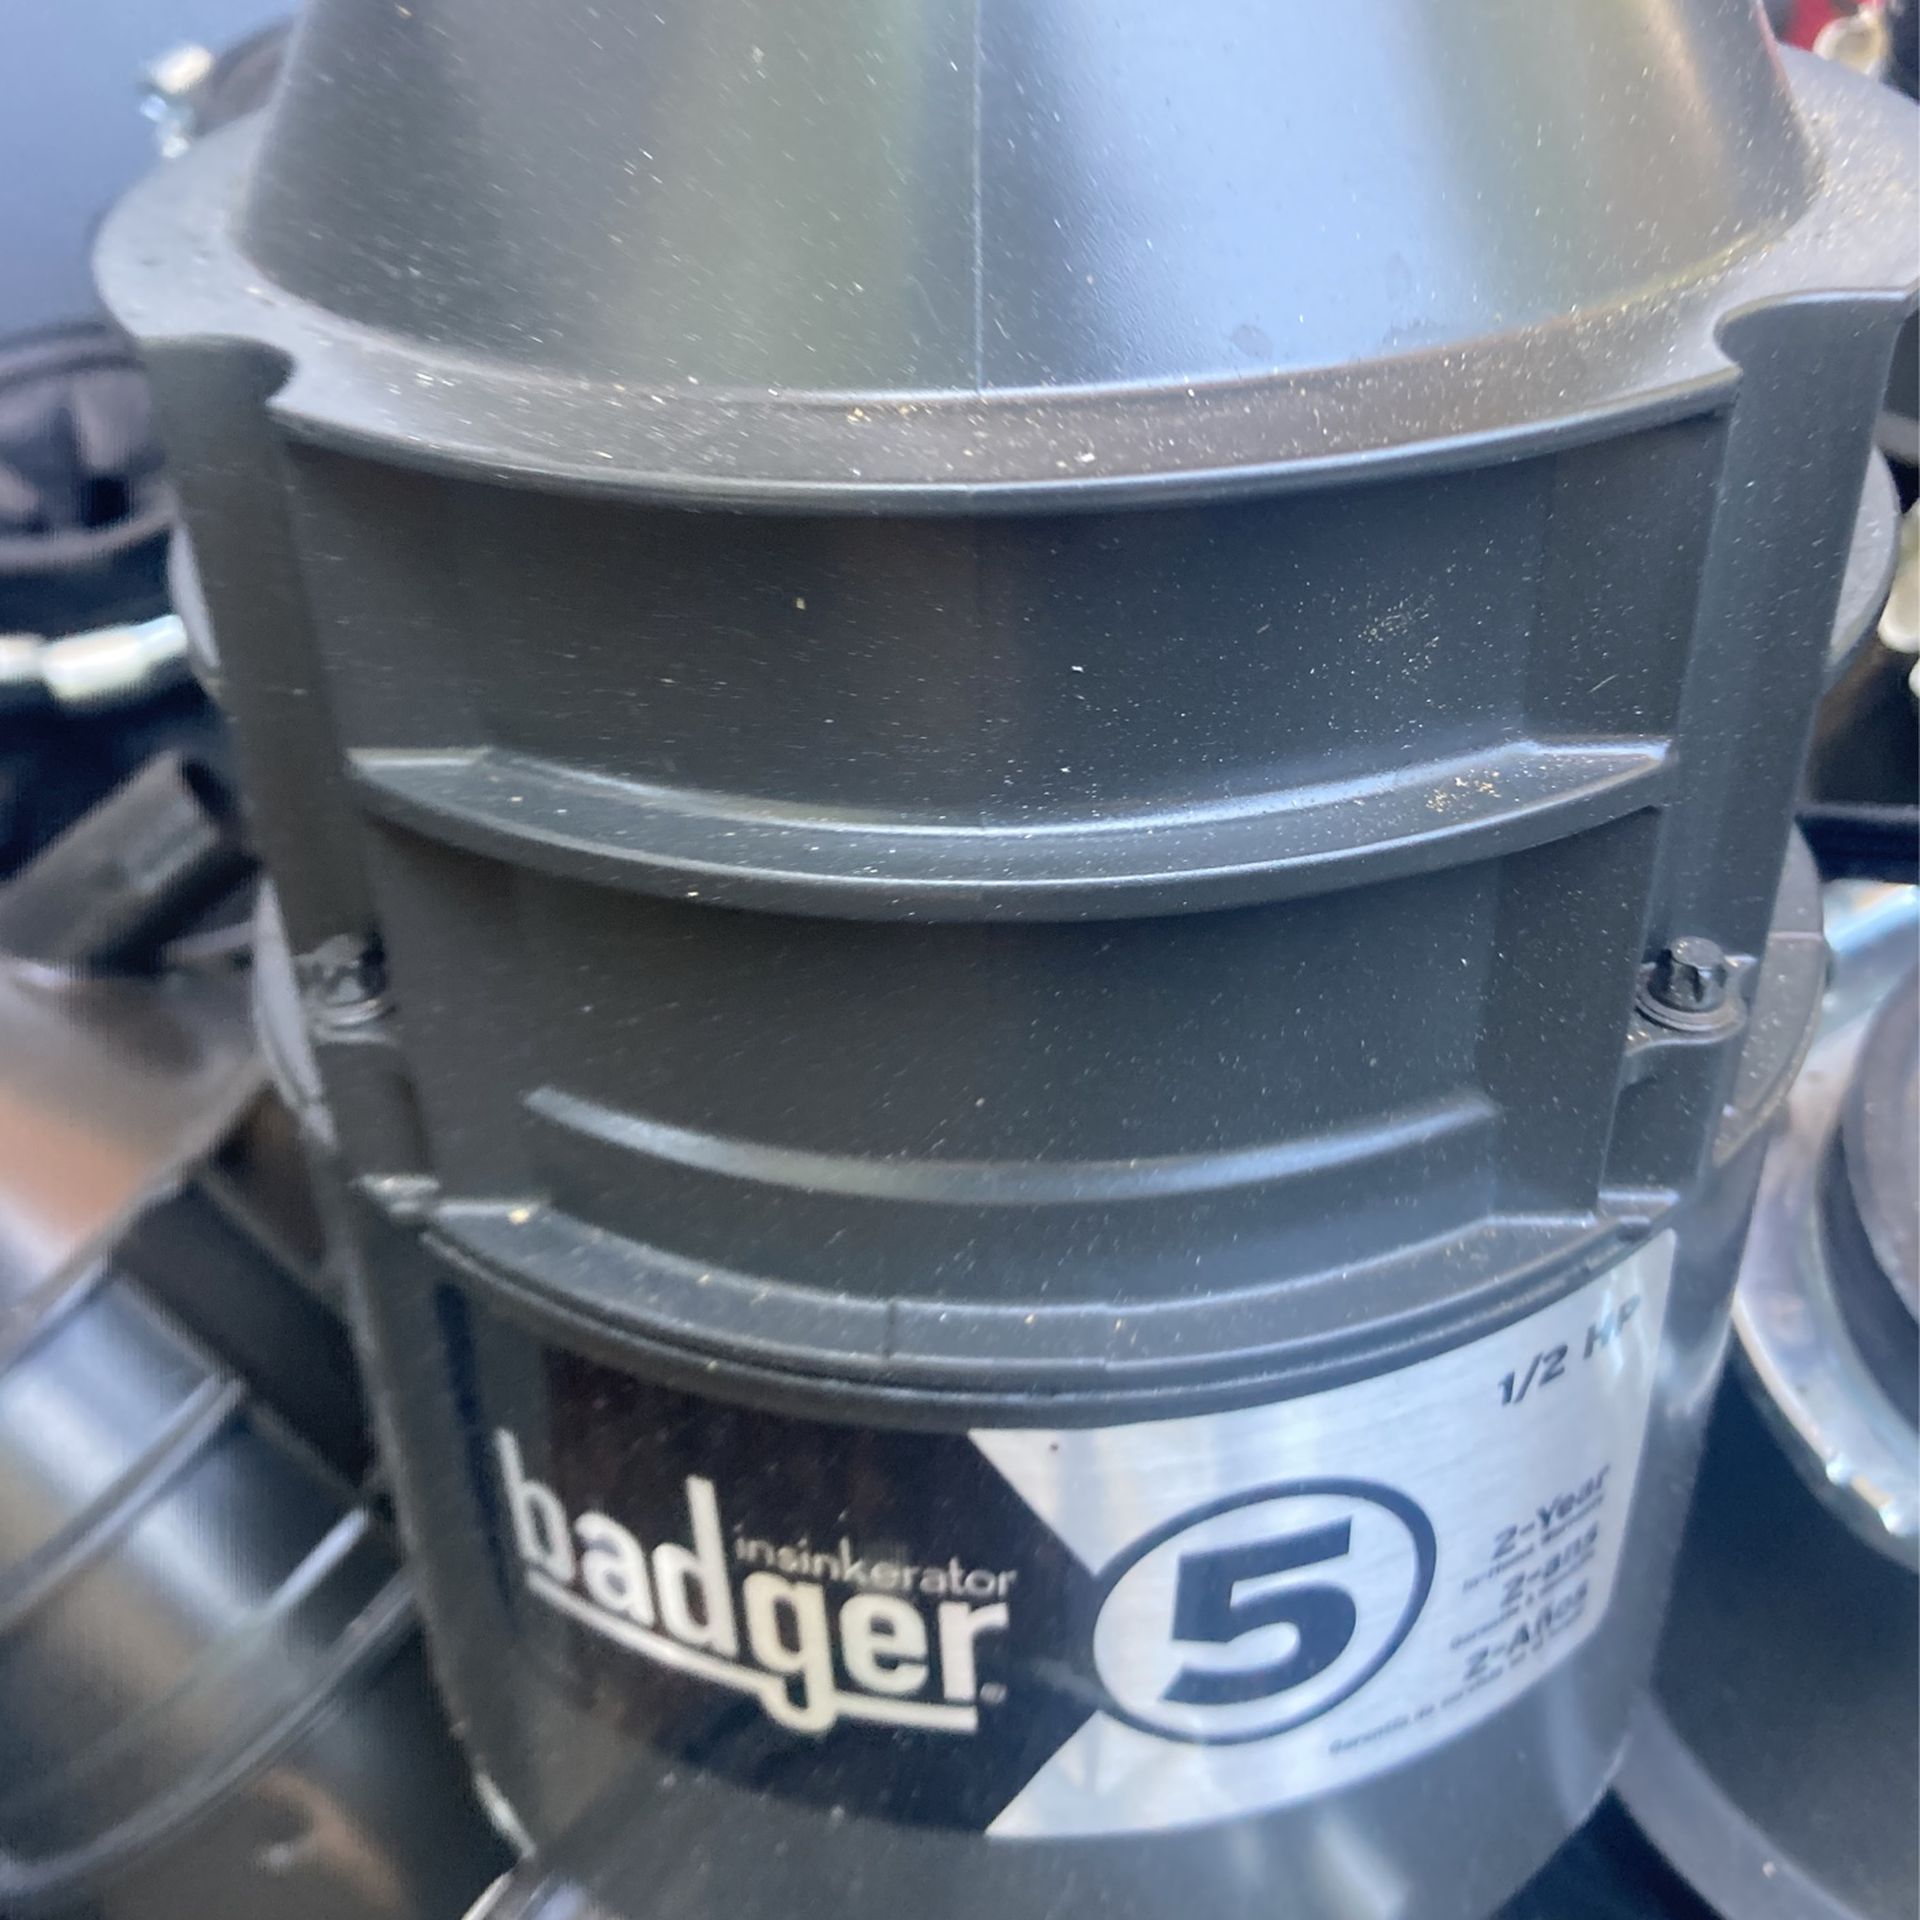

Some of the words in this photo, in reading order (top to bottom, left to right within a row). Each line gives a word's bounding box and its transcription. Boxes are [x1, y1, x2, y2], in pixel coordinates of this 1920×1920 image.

[1498, 1344, 1568, 1405] 1/2
[1584, 1294, 1641, 1360] HP
[736, 1522, 1017, 1600] insinkerator
[1493, 1463, 1610, 1559] 2-Year
[495, 1427, 1009, 1734] badger
[1160, 1516, 1358, 1705] 5
